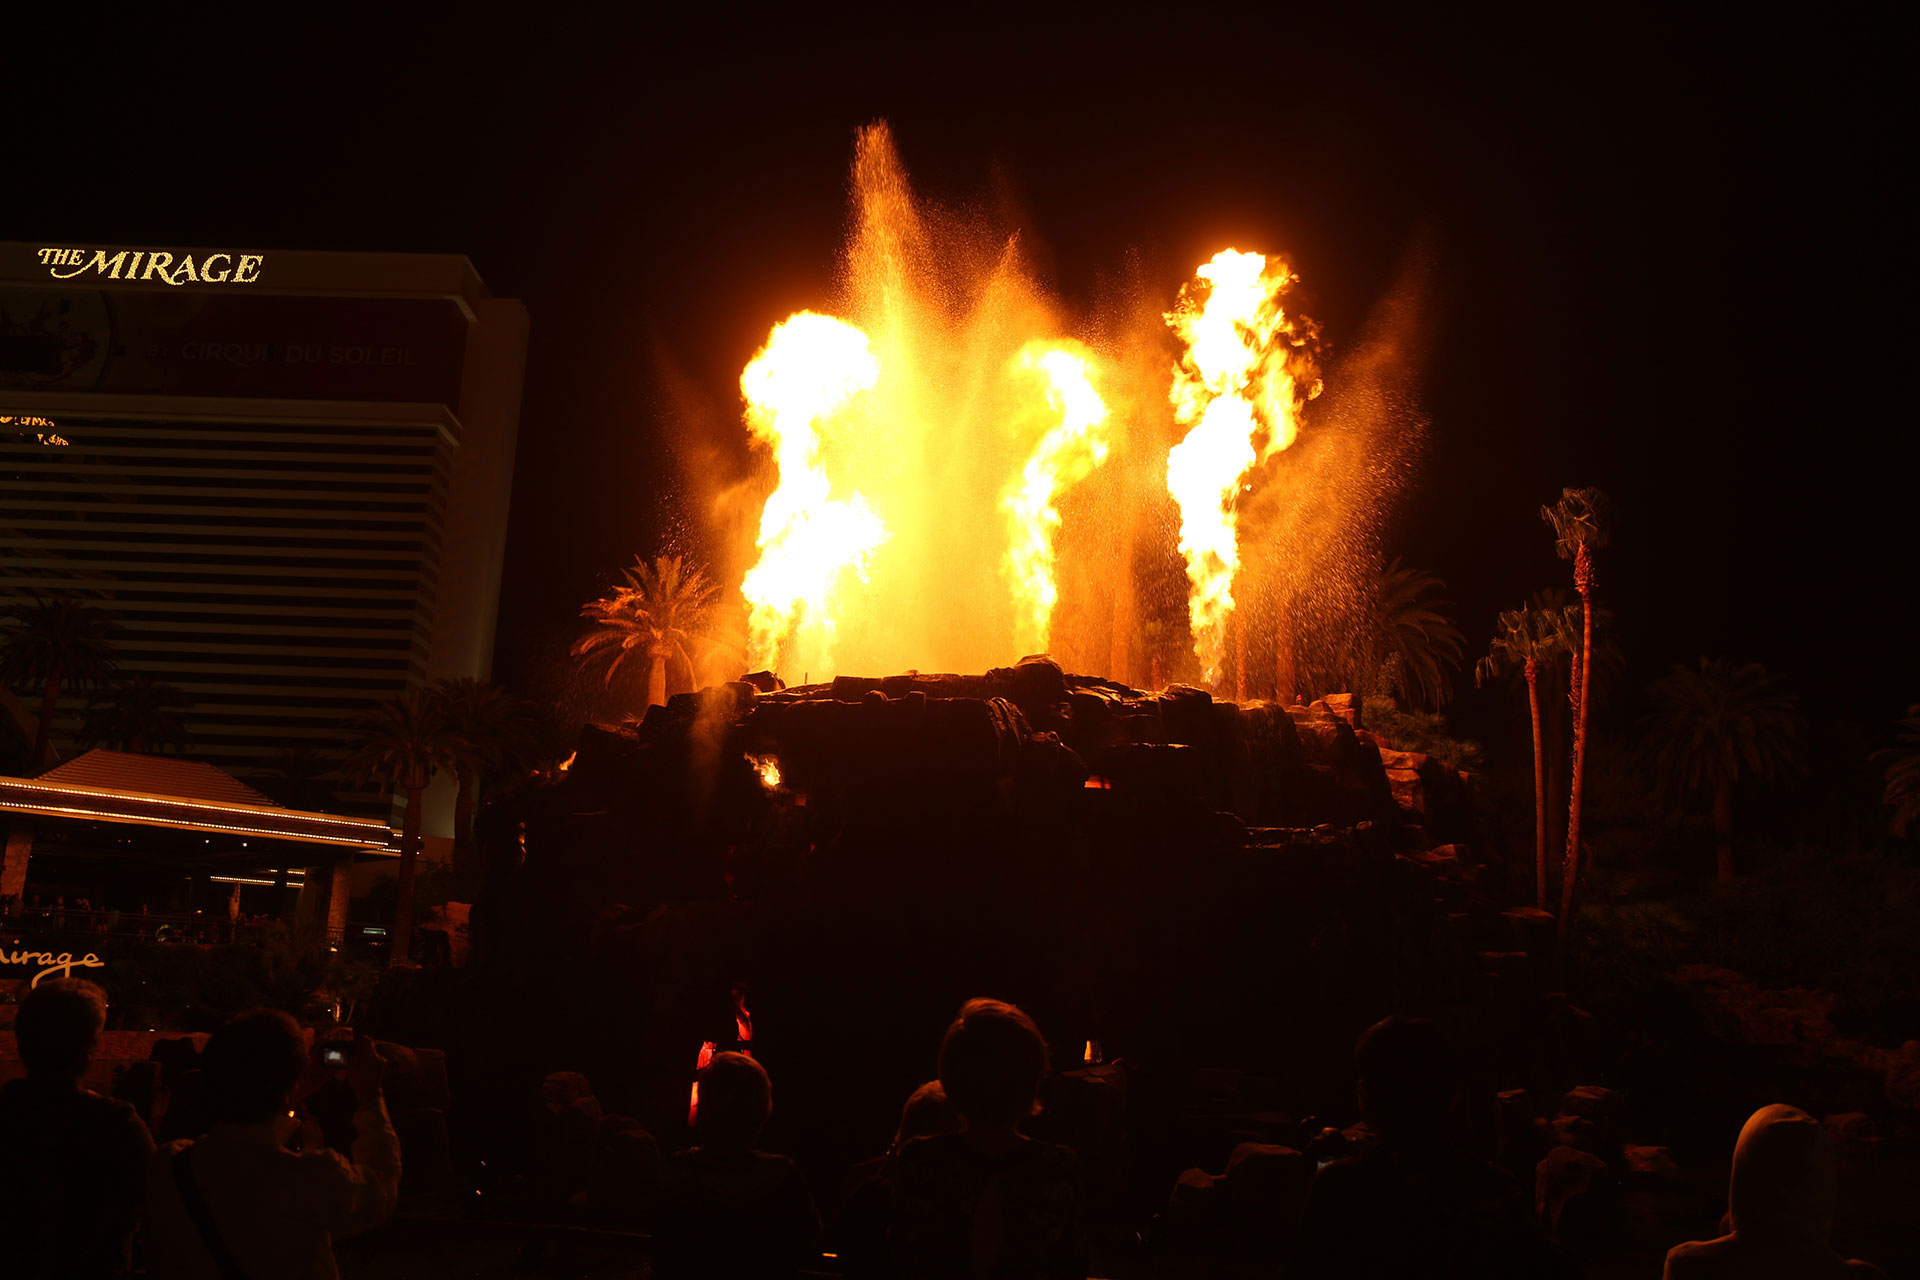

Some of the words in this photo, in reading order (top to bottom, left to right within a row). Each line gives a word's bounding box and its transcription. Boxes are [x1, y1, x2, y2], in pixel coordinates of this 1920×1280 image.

[38, 248, 85, 266] THE
[50, 250, 264, 286] MIRAGE
[285, 345, 320, 363] DU
[329, 346, 417, 367] SOLEIL
